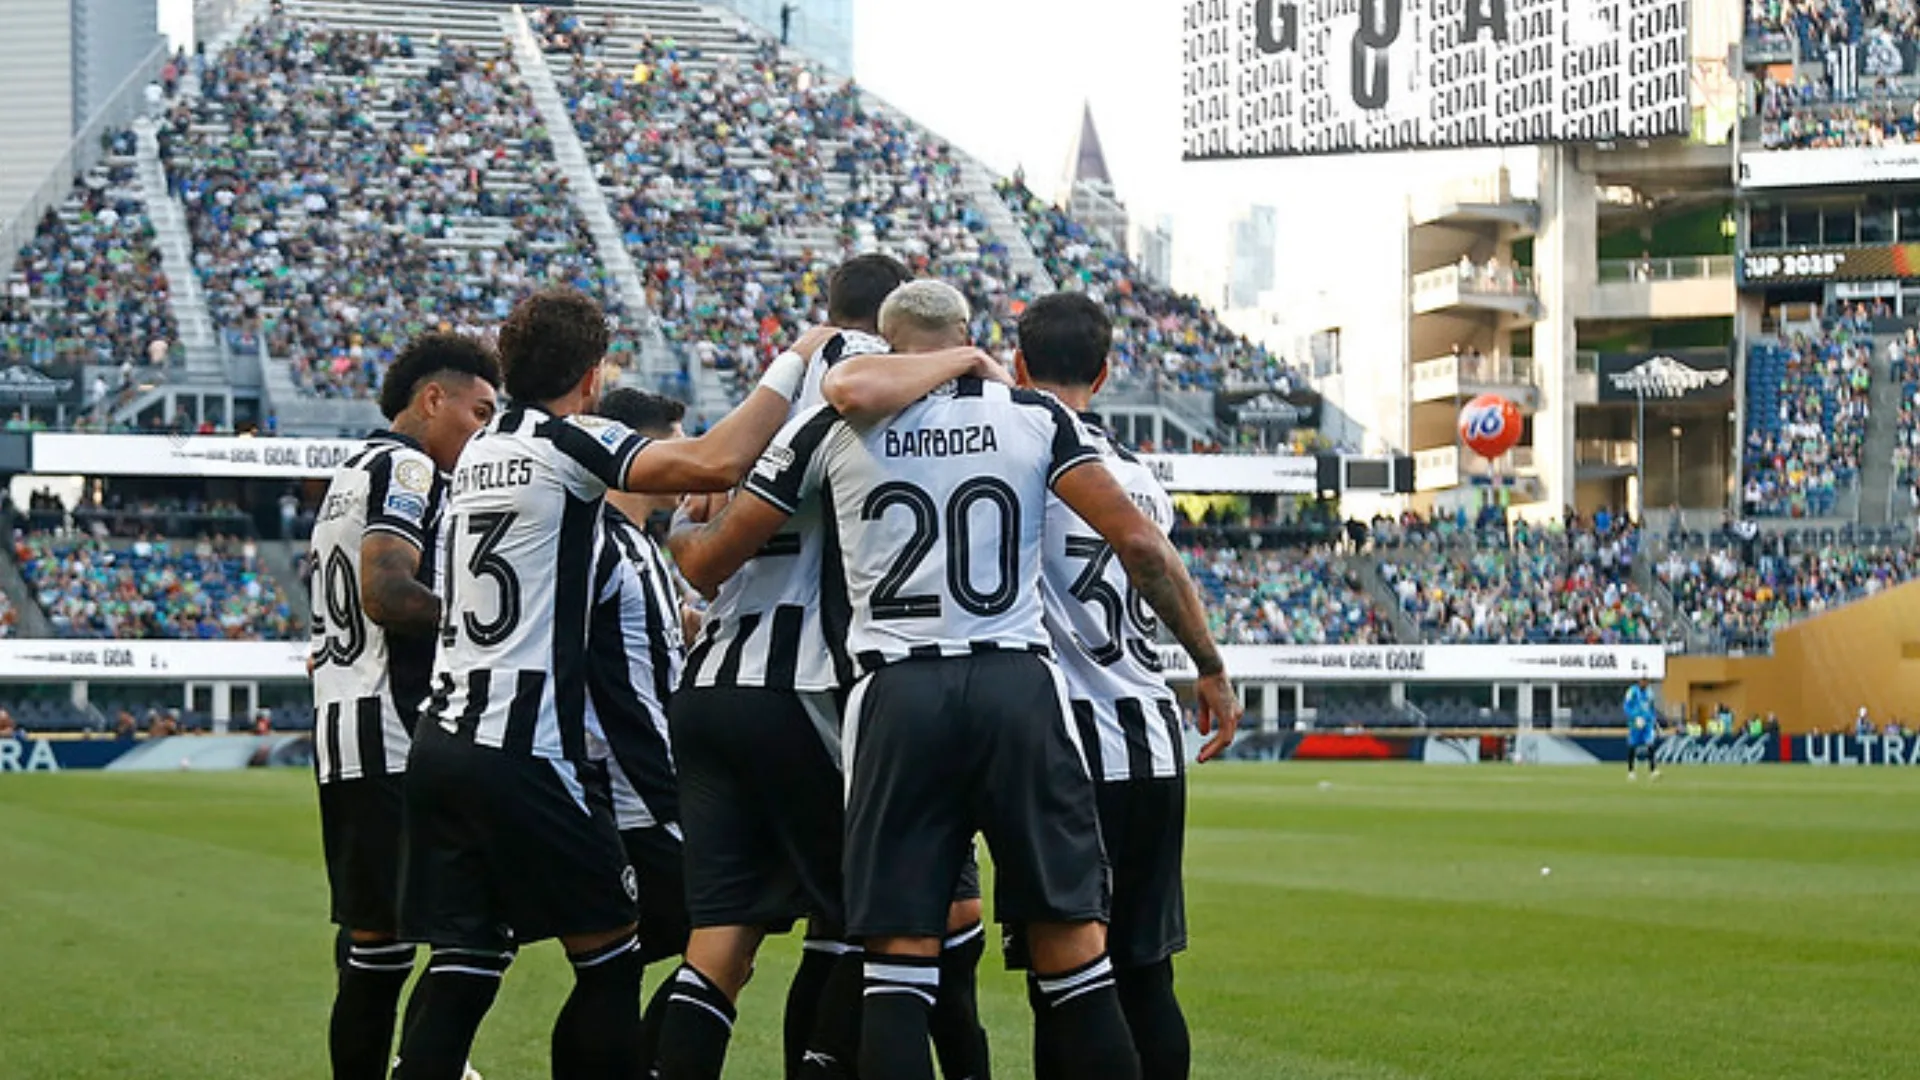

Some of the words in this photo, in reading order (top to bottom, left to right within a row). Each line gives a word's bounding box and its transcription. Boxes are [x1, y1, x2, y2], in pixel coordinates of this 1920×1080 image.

[1430, 45, 1486, 88] GOAL
[1496, 41, 1553, 85] GOAL
[1563, 38, 1620, 82] GOAL
[1630, 35, 1690, 78] GOAL
[1237, 89, 1293, 131] GOAL
[1430, 78, 1486, 121] GOAL
[1496, 75, 1553, 118] GOAL
[1563, 71, 1620, 116] GOAL
[1630, 69, 1690, 112] GOAL
[885, 424, 998, 458] BARBOZA
[861, 475, 1020, 620] 20
[440, 512, 520, 647] 13
[1655, 734, 1768, 764] Michelob
